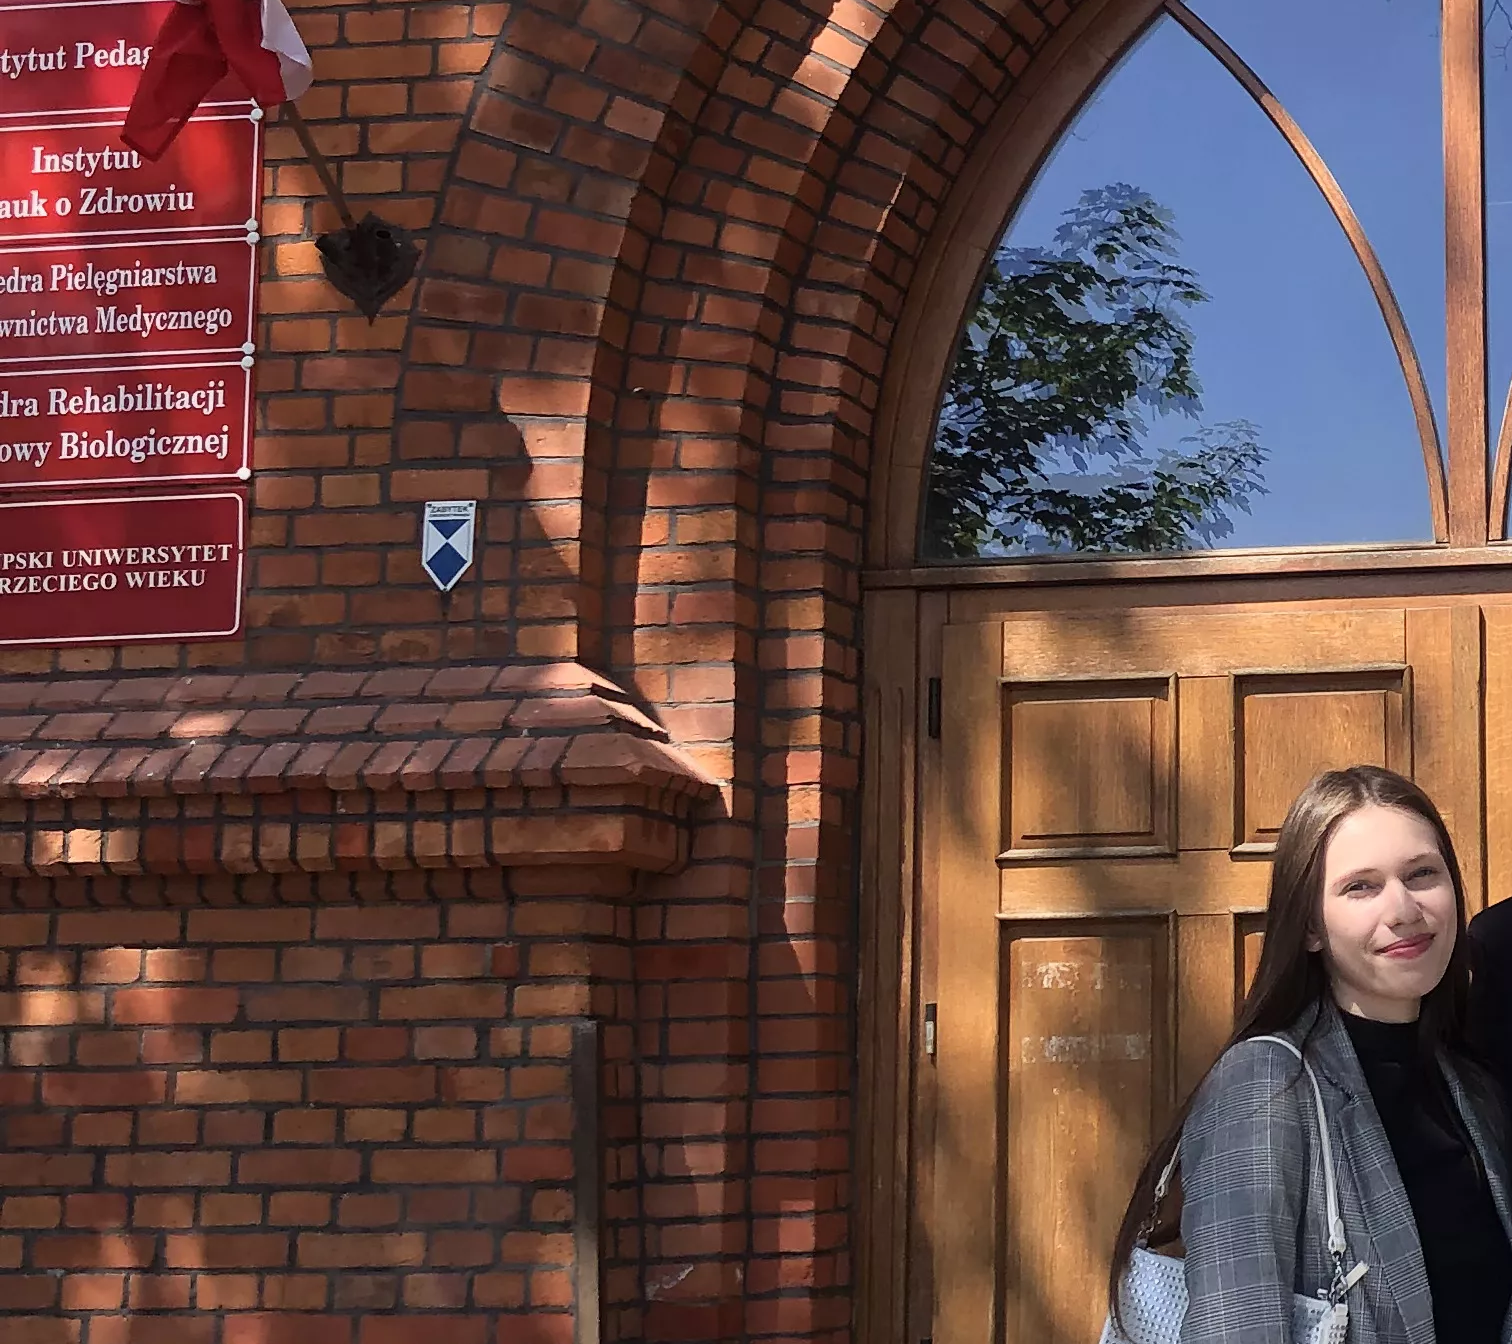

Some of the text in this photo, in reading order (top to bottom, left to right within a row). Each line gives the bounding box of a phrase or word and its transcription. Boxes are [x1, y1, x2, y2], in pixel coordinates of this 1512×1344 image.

[31, 145, 142, 177] Instytut
[55, 197, 72, 216] o
[79, 183, 195, 215] Zdrowiu
[50, 260, 218, 296] Pielęgniarstwa
[94, 304, 233, 338] Medycznego
[47, 380, 226, 416] Rehabilitacji
[58, 424, 229, 464] Biologicznej
[0, 543, 233, 571] PSKI UNIWERSYTET
[125, 568, 207, 589] WIEKU
